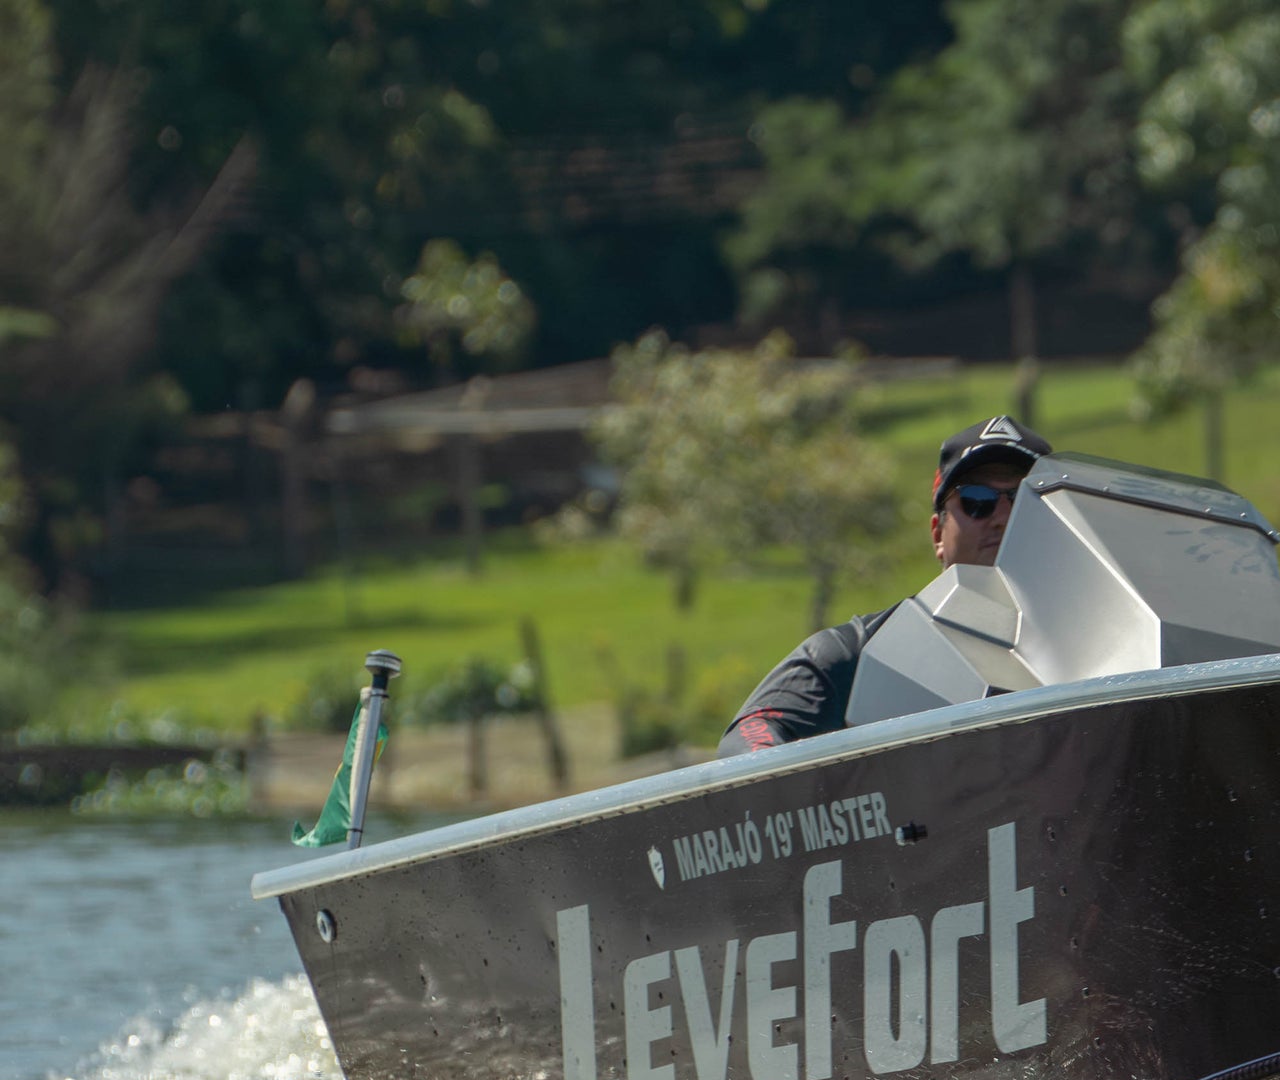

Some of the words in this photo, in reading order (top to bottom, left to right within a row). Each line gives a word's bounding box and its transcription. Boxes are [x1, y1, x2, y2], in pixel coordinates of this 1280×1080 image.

[673, 810, 762, 881] MARAJÓ
[765, 811, 793, 860] 19'
[797, 791, 892, 852] MASTER
